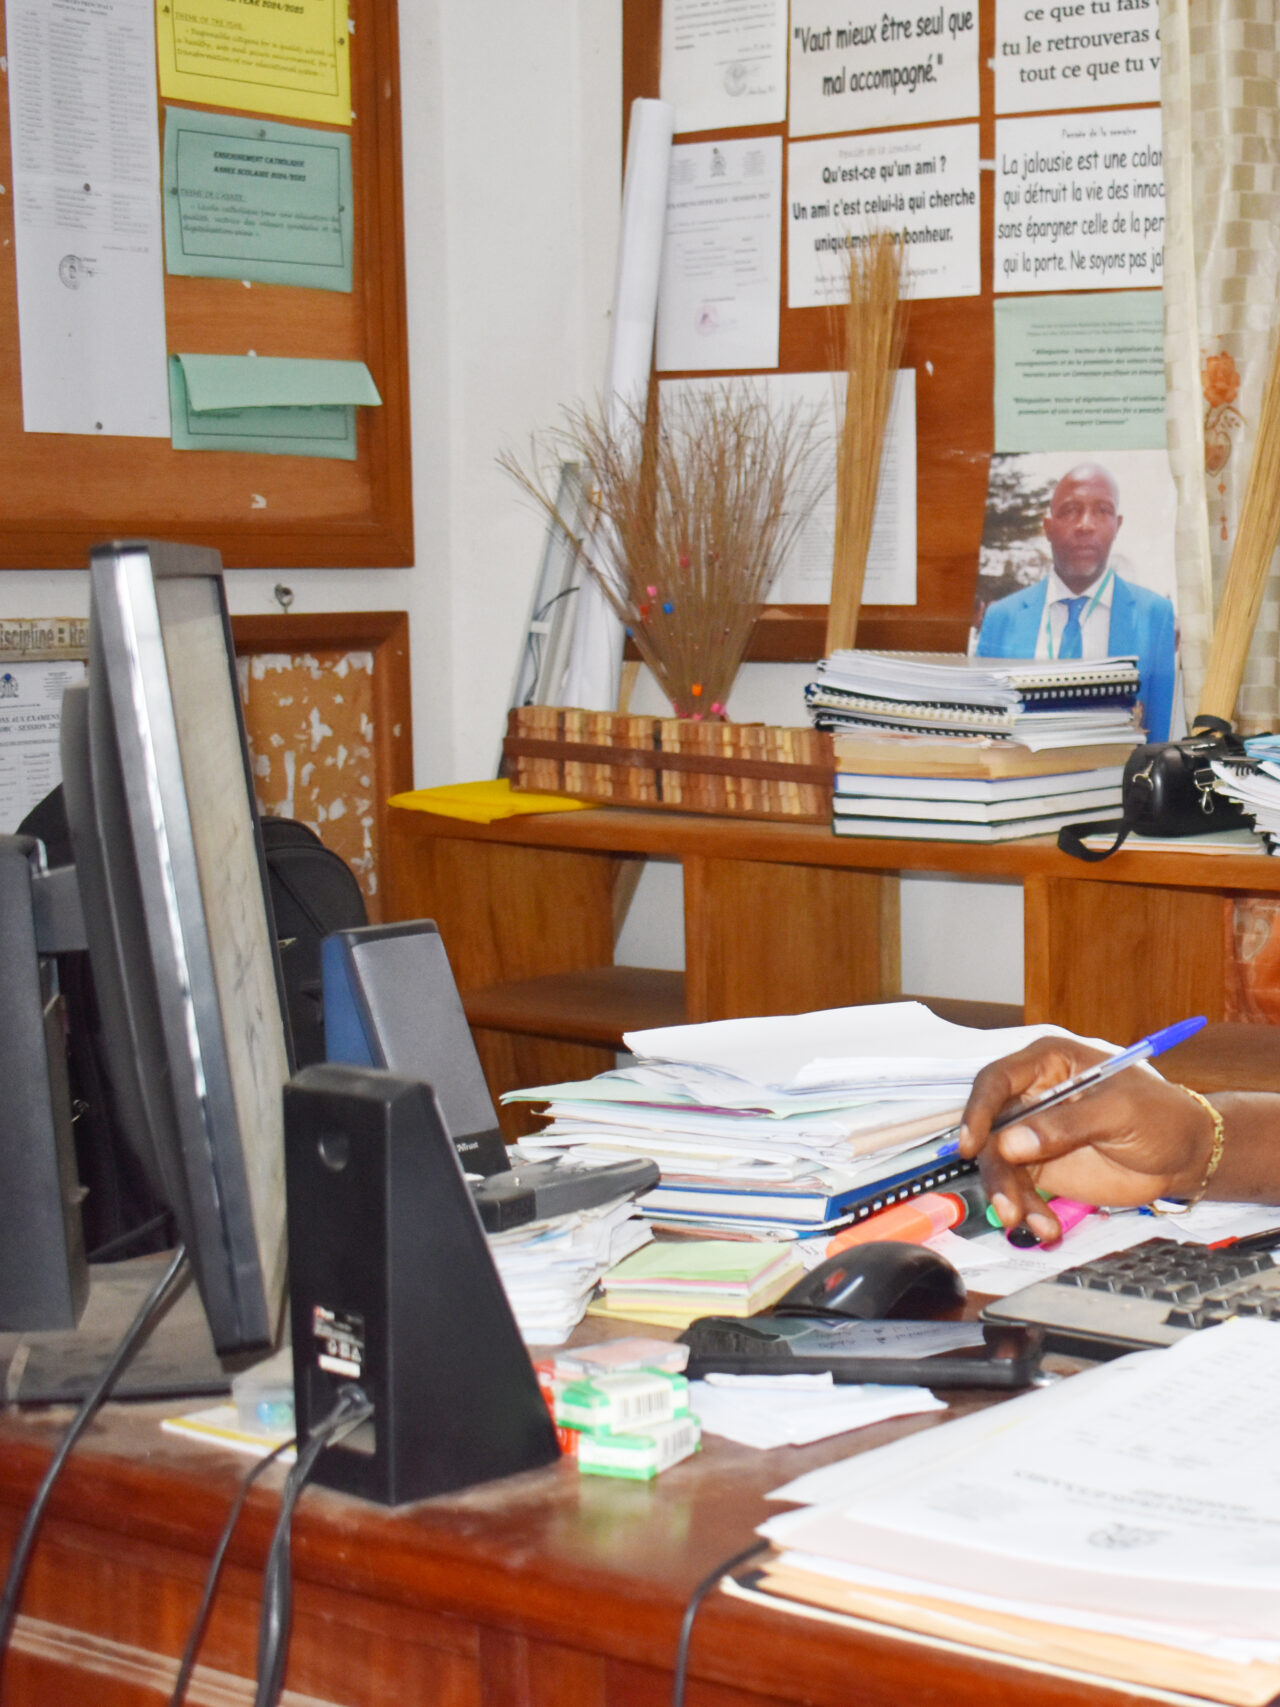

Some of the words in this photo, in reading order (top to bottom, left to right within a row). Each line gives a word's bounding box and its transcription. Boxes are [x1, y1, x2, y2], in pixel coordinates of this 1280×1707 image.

[1024, 8, 1044, 21] ce
[1050, 3, 1085, 22] que
[1091, 0, 1110, 14] tu
[795, 26, 831, 53] "Vaut
[837, 21, 877, 49] mieux
[881, 13, 912, 41] être
[916, 6, 944, 36] seul
[949, 11, 973, 39] que
[1002, 41, 1020, 56] tu
[1026, 35, 1041, 54] le
[1047, 29, 1149, 51] retrouveras
[823, 66, 846, 95] mal
[851, 53, 943, 94] accompagné."
[1019, 65, 1056, 83] tout
[1062, 65, 1081, 78] ce
[1086, 60, 1119, 80] que
[1125, 57, 1144, 72] tu
[822, 165, 876, 184] Qu'est-ce
[880, 160, 911, 182] qu'un
[915, 157, 936, 175] ami
[940, 155, 947, 172] ?
[1002, 154, 1018, 176] La
[1021, 151, 1073, 181] jalousie
[1077, 151, 1099, 171] est
[1104, 152, 1127, 169] une
[793, 202, 807, 220] Un
[811, 200, 830, 218] ami
[833, 198, 860, 216] c'est
[864, 193, 904, 213] celui-là
[909, 191, 926, 214] qui
[930, 187, 975, 208] cherche
[1004, 185, 1020, 211] qui
[1024, 182, 1067, 204] détruit
[1072, 181, 1082, 201] la
[1086, 181, 1103, 200] vie
[1107, 179, 1129, 200] des
[903, 225, 953, 244] bonheur.
[999, 221, 1022, 239] sans
[1026, 215, 1078, 244] épargner
[1081, 212, 1108, 235] celle
[1113, 212, 1126, 233] de
[1131, 211, 1140, 233] la
[1003, 254, 1019, 279] qui
[1022, 251, 1031, 272] la
[1035, 254, 1067, 278] porte.
[1071, 250, 1085, 270] Ne
[1089, 252, 1125, 275] soyons
[1130, 251, 1146, 274] pas
